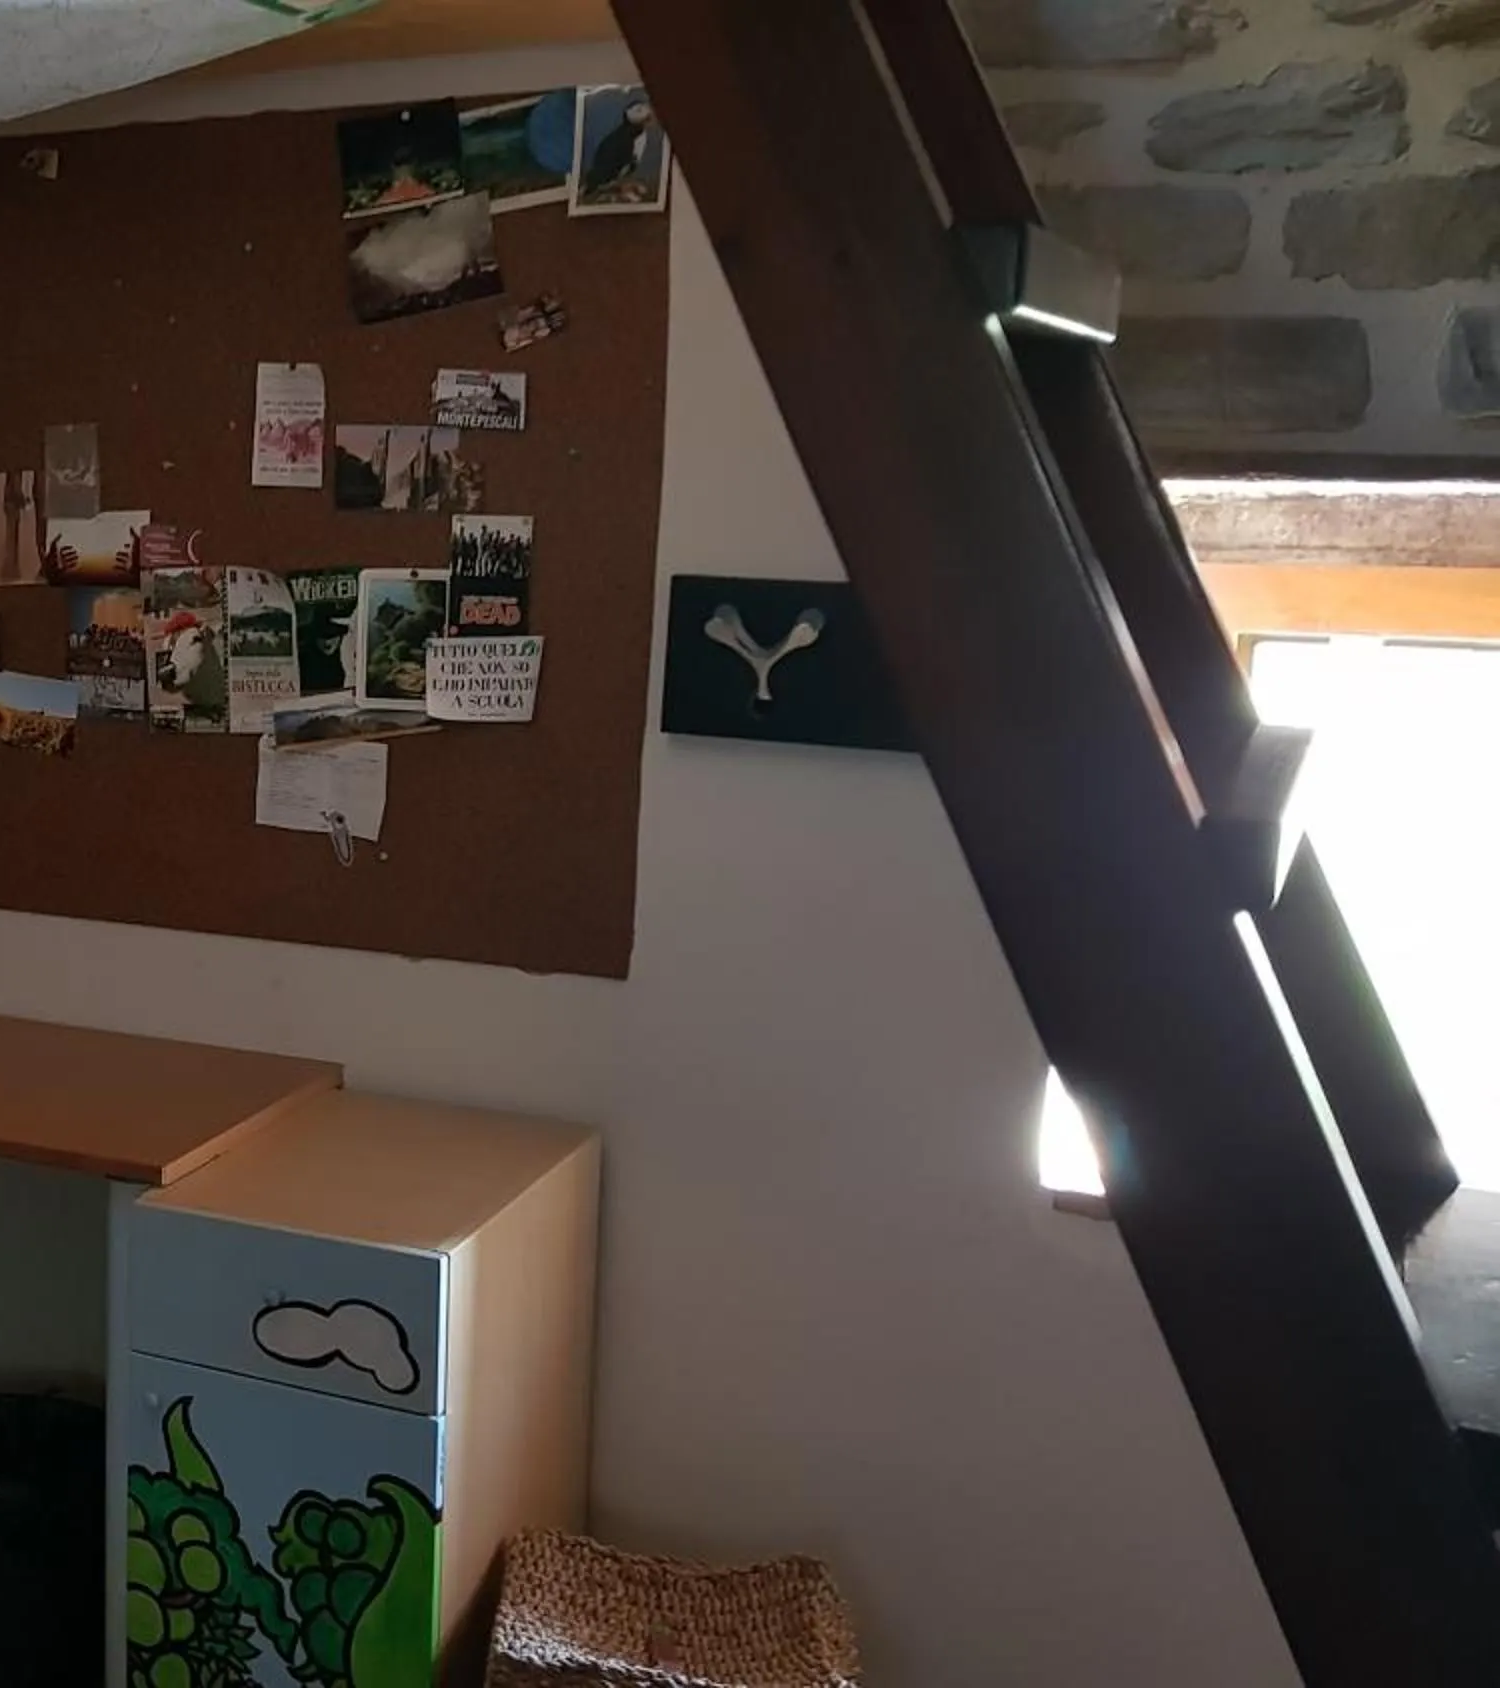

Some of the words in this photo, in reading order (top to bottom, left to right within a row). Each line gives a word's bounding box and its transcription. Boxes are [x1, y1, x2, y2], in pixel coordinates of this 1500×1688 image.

[436, 411, 518, 429] MONTEPESCALI
[290, 576, 357, 601] WICKED
[459, 599, 522, 627] DEAD
[432, 643, 478, 657] TUTTO
[440, 662, 473, 675] CHE
[478, 661, 506, 675] NON
[512, 661, 530, 674] SO
[467, 694, 524, 709] SCUOLA
